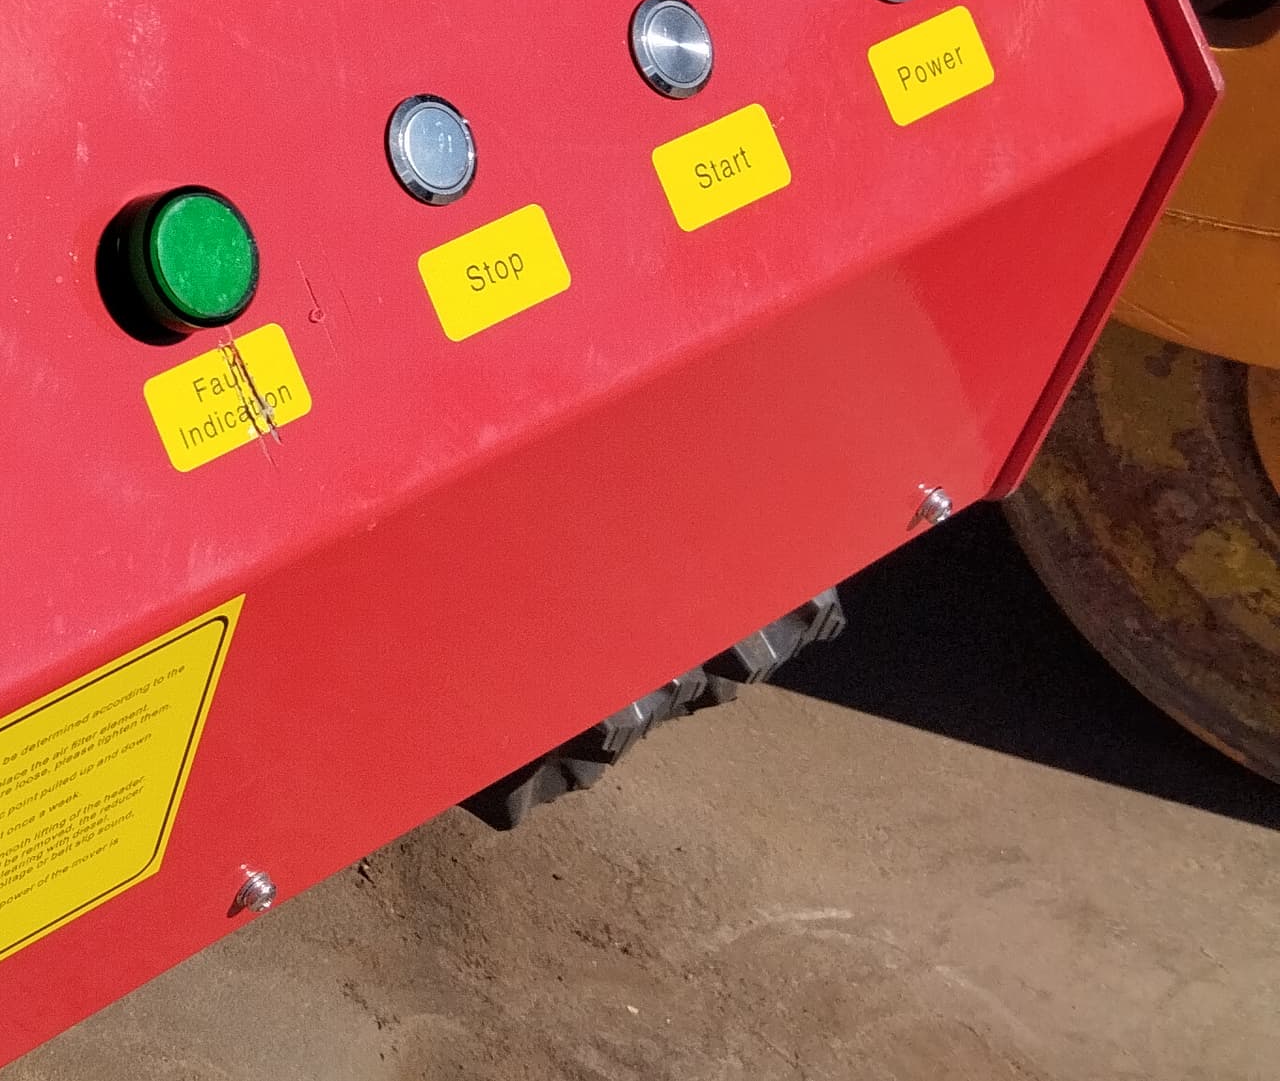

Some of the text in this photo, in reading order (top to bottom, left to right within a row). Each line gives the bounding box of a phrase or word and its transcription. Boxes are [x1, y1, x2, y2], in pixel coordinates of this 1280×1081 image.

[896, 46, 964, 92] Power
[694, 146, 752, 189] Start
[466, 252, 524, 292] Stop
[192, 364, 248, 403] Faul
[179, 384, 293, 449] Indicaton
